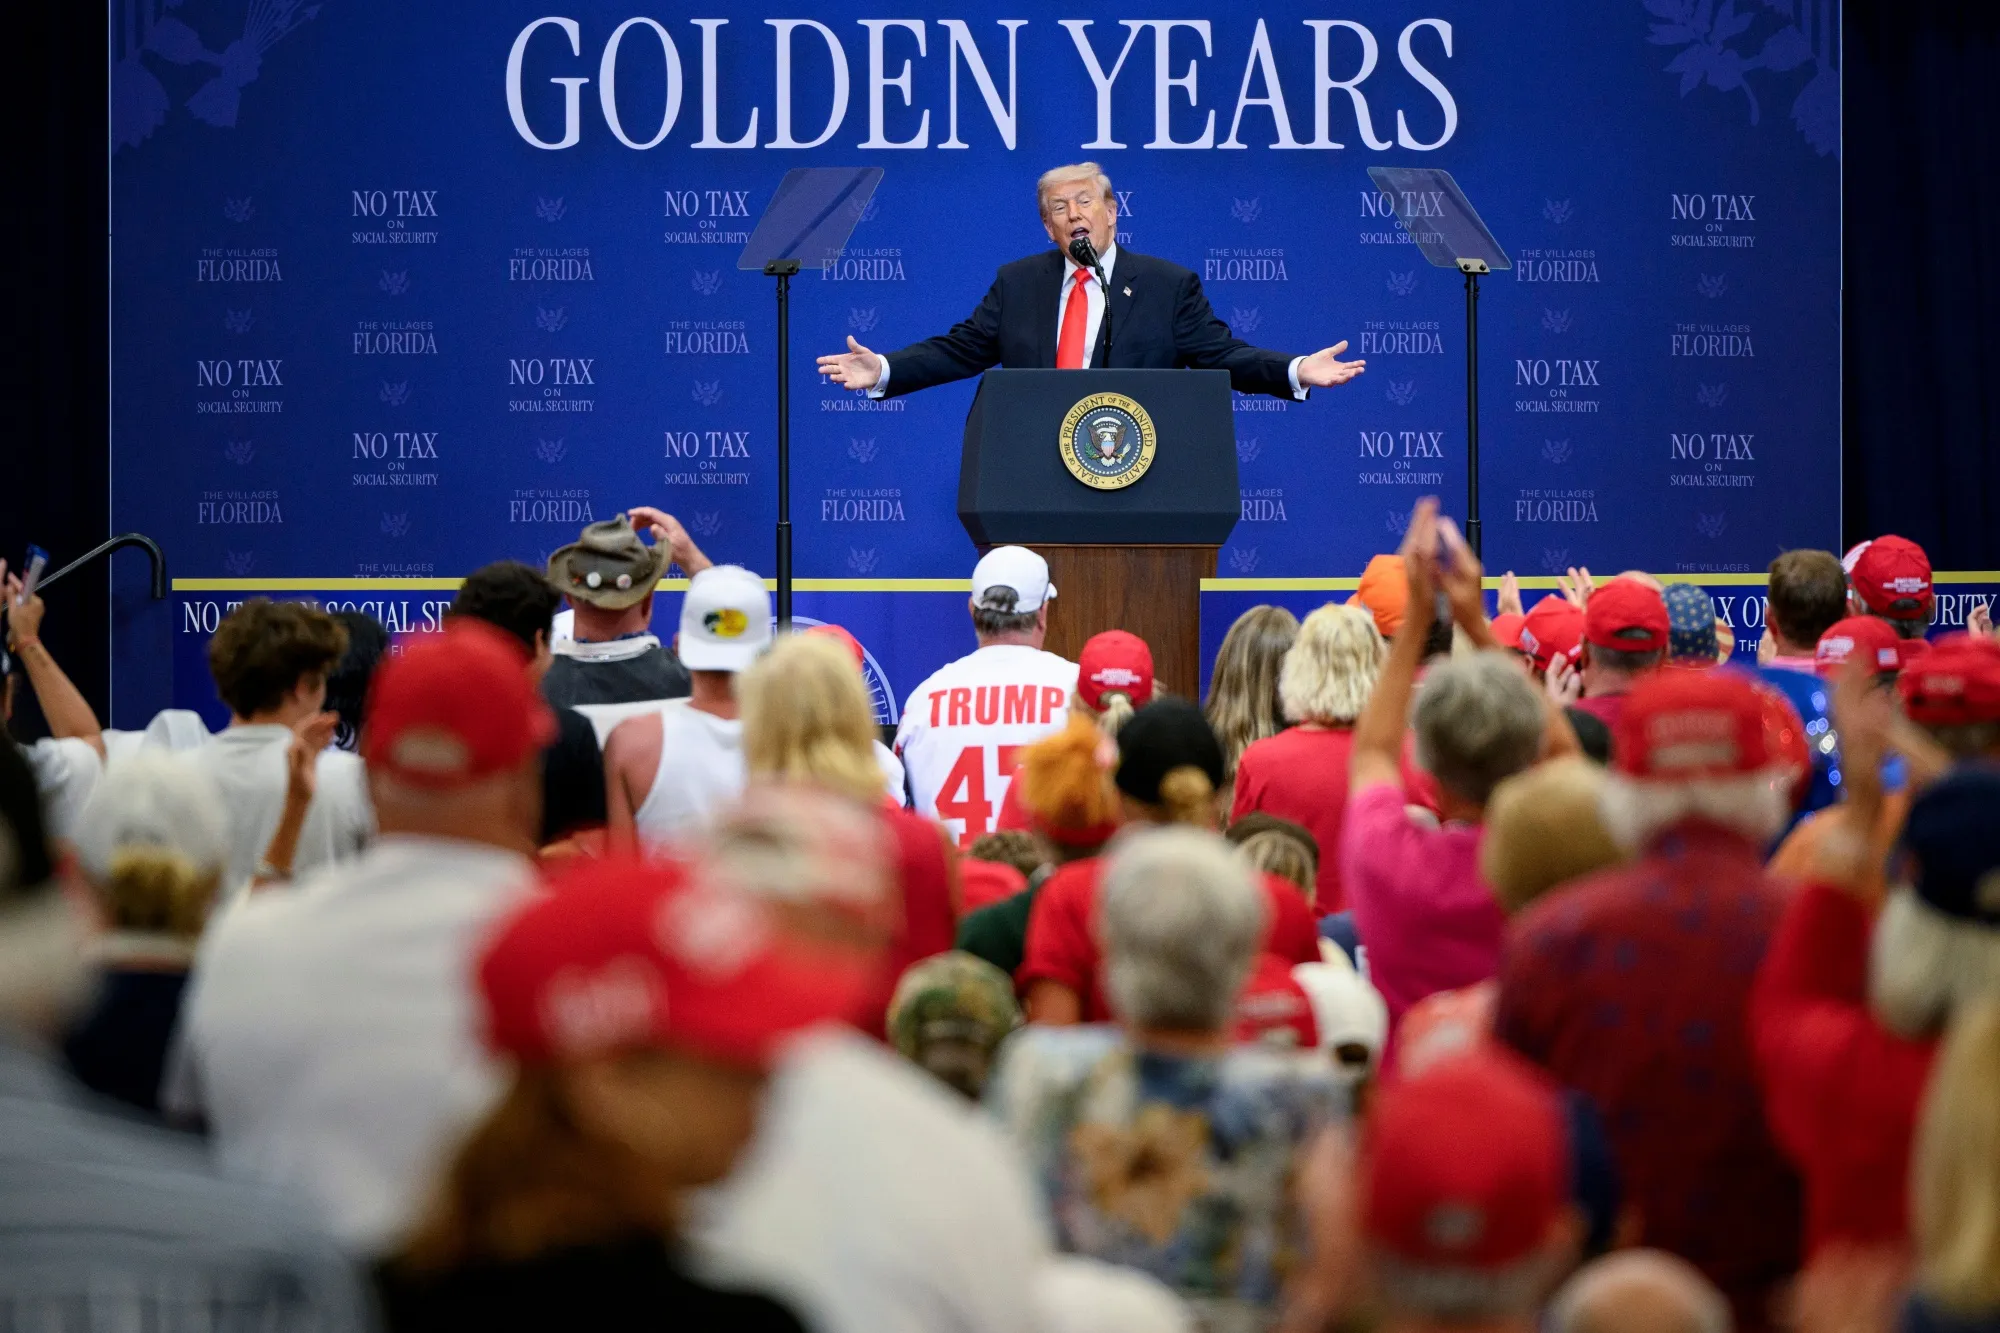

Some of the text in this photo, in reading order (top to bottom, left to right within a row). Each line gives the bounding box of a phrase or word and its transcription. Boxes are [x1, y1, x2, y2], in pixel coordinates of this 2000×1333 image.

[506, 16, 1458, 151] GOLDEN YEARS
[352, 190, 438, 217] NO TAX
[664, 190, 750, 217] NO TAX
[1359, 190, 1445, 217] NO TAX
[1670, 194, 1756, 221] NO TAX
[387, 219, 405, 229] ON
[699, 219, 717, 229] ON
[1394, 219, 1412, 229] ON
[1705, 223, 1723, 233] ON
[352, 231, 438, 244] SOCIAL SECURITY
[664, 231, 750, 244] SOCIAL SECURITY
[1359, 231, 1445, 244] SOCIAL SECURITY
[1670, 235, 1756, 248] SOCIAL SECURITY
[202, 249, 278, 258] THE VILLAGES
[513, 248, 589, 257] THE VILLAGES
[849, 248, 901, 257] VILLAGES
[1208, 248, 1284, 257] THE VILLAGES
[1520, 249, 1596, 258] THE VILLAGES
[197, 259, 283, 281] FLORIDA
[508, 258, 594, 280] FLORIDA
[820, 258, 906, 280] FLORIDA
[1203, 258, 1289, 280] FLORIDA
[1515, 259, 1601, 281] FLORIDA
[357, 321, 433, 330] THE VILLAGES
[669, 321, 745, 330] THE VILLAGES
[1364, 321, 1440, 330] THE VILLAGES
[1675, 324, 1751, 333] THE VILLAGES
[352, 331, 438, 353] FLORIDA
[664, 331, 750, 353] FLORIDA
[1359, 331, 1445, 353] FLORIDA
[1670, 334, 1756, 356] FLORIDA
[197, 359, 283, 386] NO TAX
[508, 358, 594, 385] NO TAX
[1514, 359, 1600, 386] NO TAX
[232, 388, 250, 398] ON
[543, 387, 561, 397] ON
[1549, 388, 1567, 398] ON
[197, 400, 283, 413] SOCIAL SECURITY
[508, 399, 594, 412] SOCIAL SECURITY
[820, 400, 907, 412] SOCIAL SECURITY
[1107, 397, 1117, 405] OF
[1118, 399, 1131, 409] THE
[1239, 399, 1288, 411] SECURITY
[1514, 400, 1600, 413] SOCIAL SECURITY
[1063, 396, 1105, 439] PRESIDENT
[1132, 408, 1153, 447] UNITED
[352, 432, 438, 458] NO TAX
[664, 431, 750, 458] NO TAX
[1358, 431, 1444, 458] NO TAX
[1669, 433, 1755, 460] NO TAX
[387, 460, 405, 470] ON
[699, 460, 717, 470] ON
[1116, 455, 1149, 485] STATES
[1393, 460, 1411, 470] ON
[1704, 462, 1722, 472] ON
[352, 472, 438, 486] SOCIAL SECURITY
[664, 472, 750, 485] SOCIAL SECURITY
[1075, 464, 1100, 485] SEAL
[1358, 472, 1444, 485] SOCIAL SECURITY
[1669, 474, 1755, 487] SOCIAL SECURITY
[202, 491, 278, 500] THE VILLAGES
[514, 490, 590, 499] THE VILLAGES
[825, 489, 901, 498] THE VILLAGES
[1519, 489, 1595, 498] THE VILLAGES
[197, 501, 283, 523] FLORIDA
[509, 500, 595, 522] FLORIDA
[820, 499, 906, 521] FLORIDA
[1240, 499, 1287, 521] RIDA
[1514, 499, 1600, 521] FLORIDA
[357, 563, 433, 572] THE VILLAGES
[1675, 563, 1751, 572] THE VILLAGES
[182, 601, 220, 633] NO
[1739, 639, 1762, 652] TH
[928, 684, 1065, 728] TRUMP
